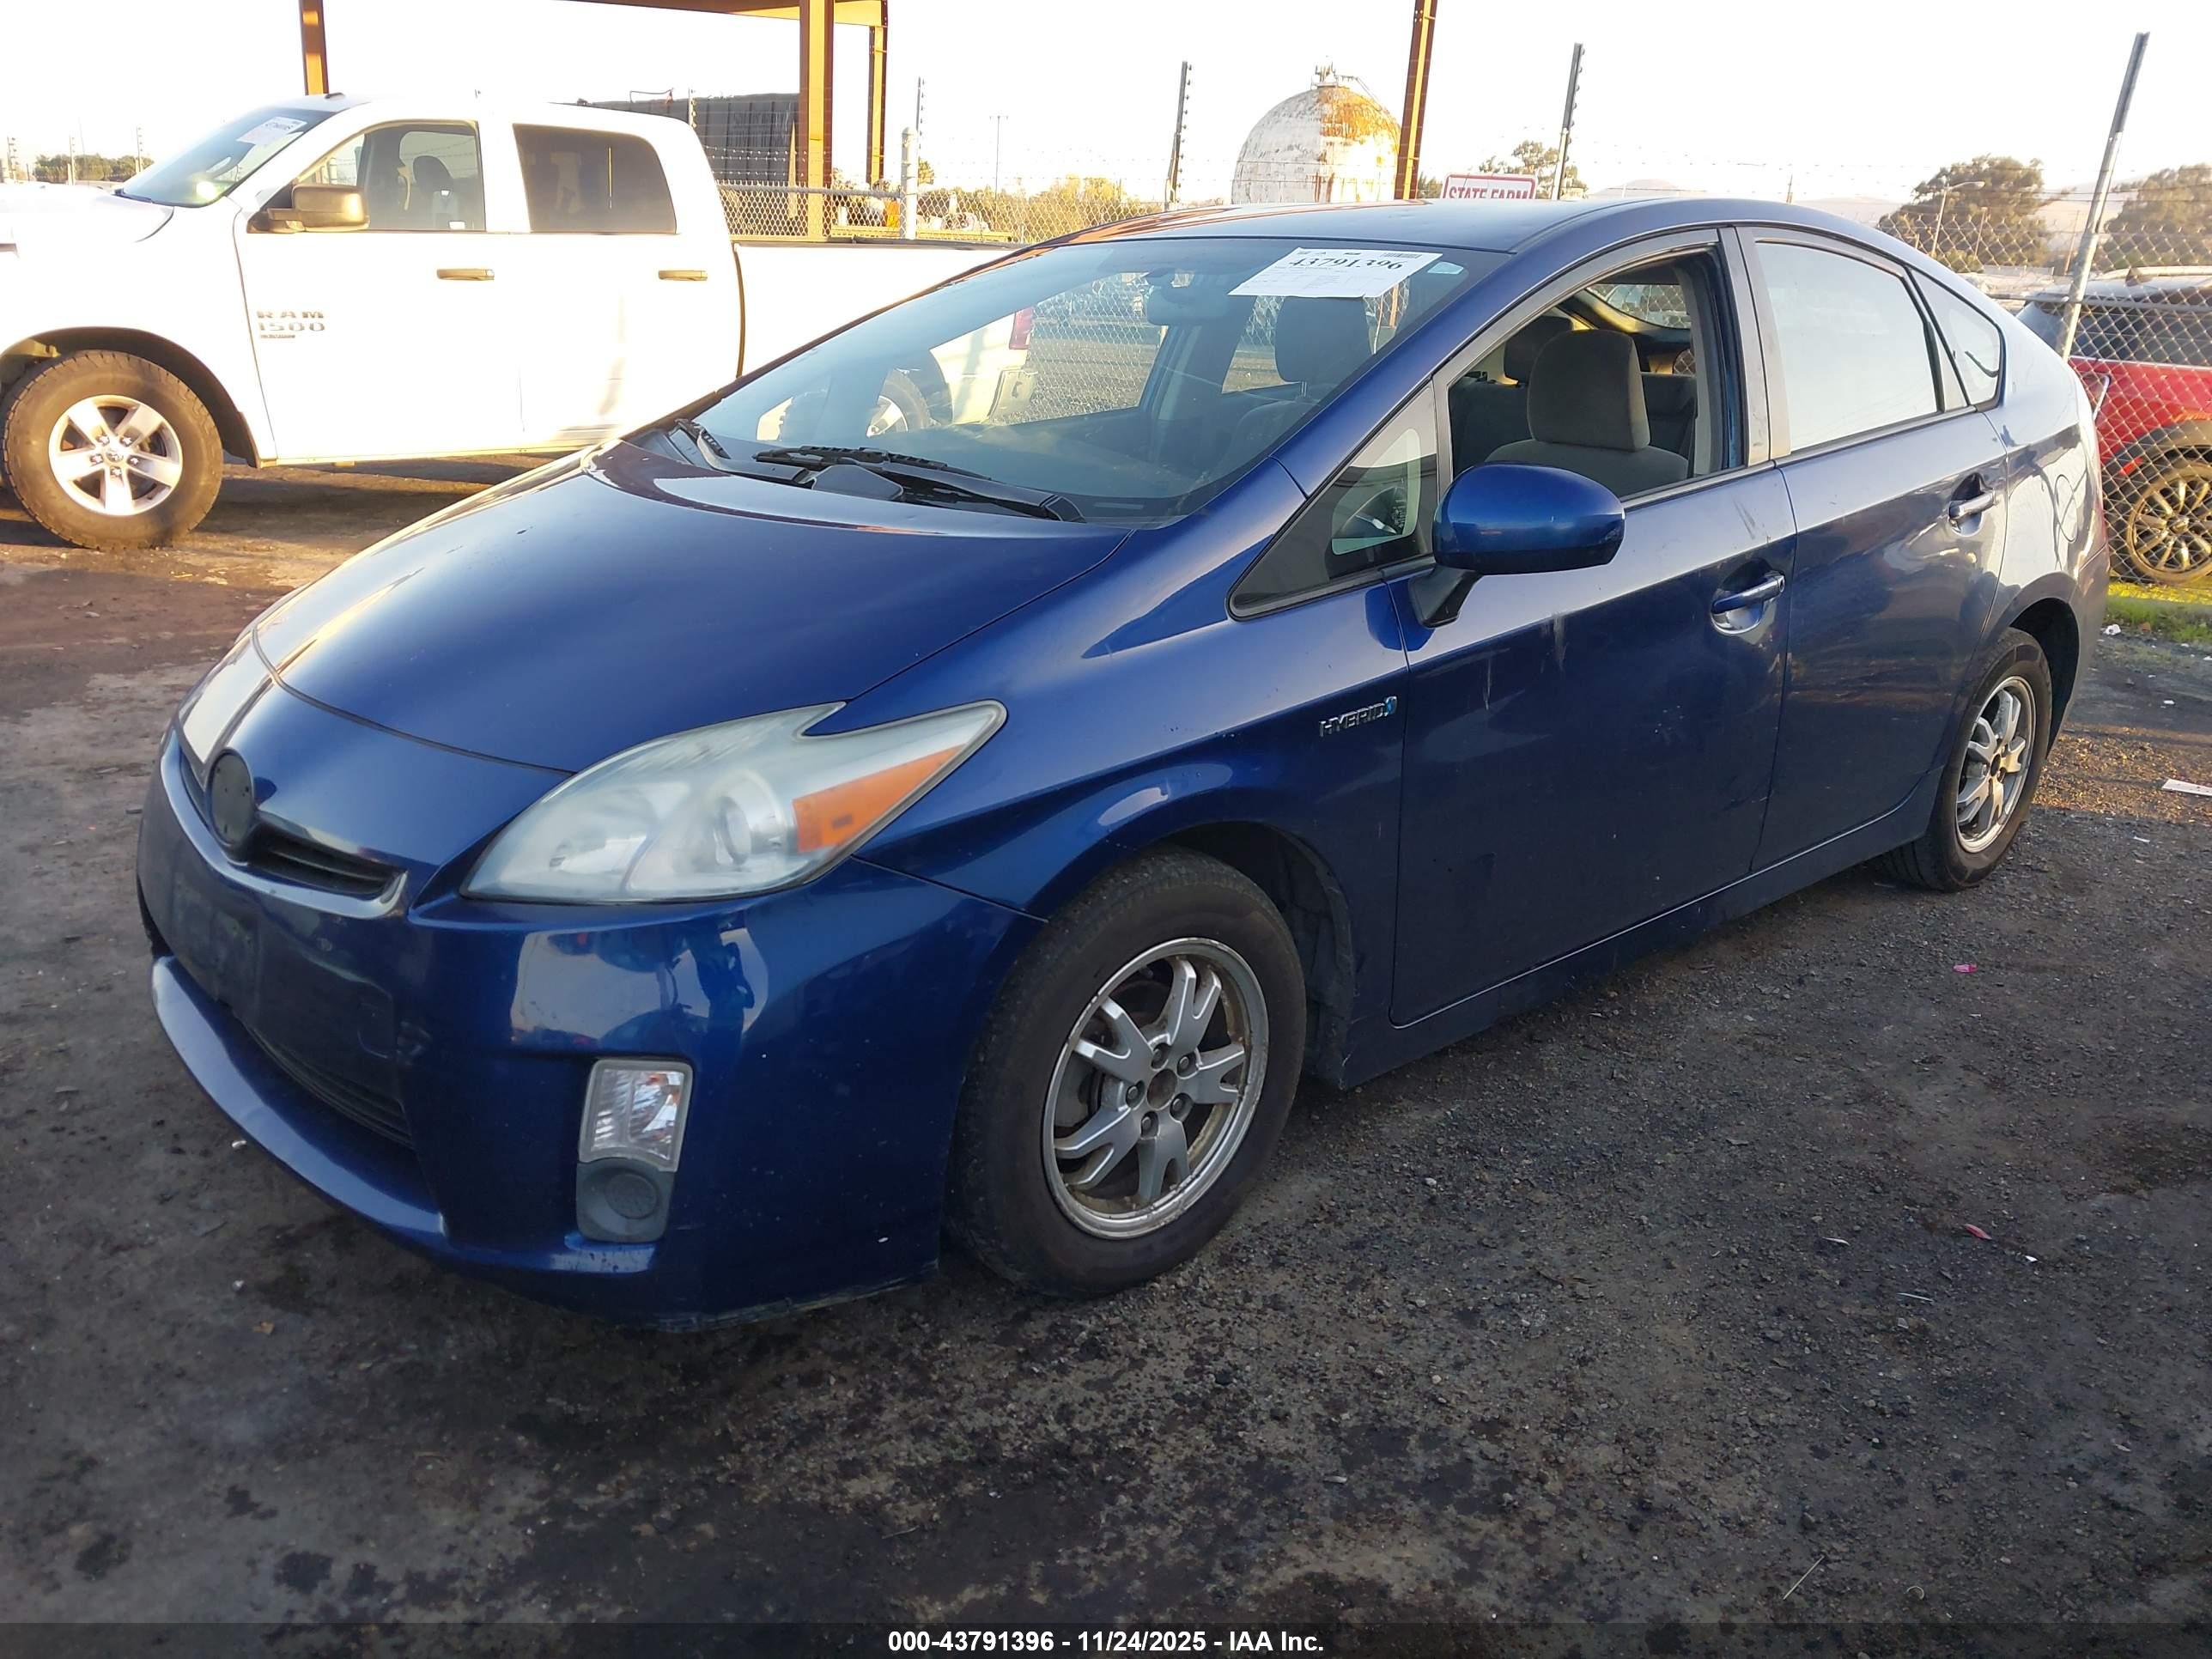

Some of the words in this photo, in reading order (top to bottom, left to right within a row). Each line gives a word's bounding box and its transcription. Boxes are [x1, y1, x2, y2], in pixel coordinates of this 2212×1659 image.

[1449, 186, 1487, 199] STATE
[1490, 188, 1528, 199] FARM
[1289, 257, 1404, 270] 43791396
[258, 322, 325, 331] 1500
[1319, 702, 1389, 737] HYBRID
